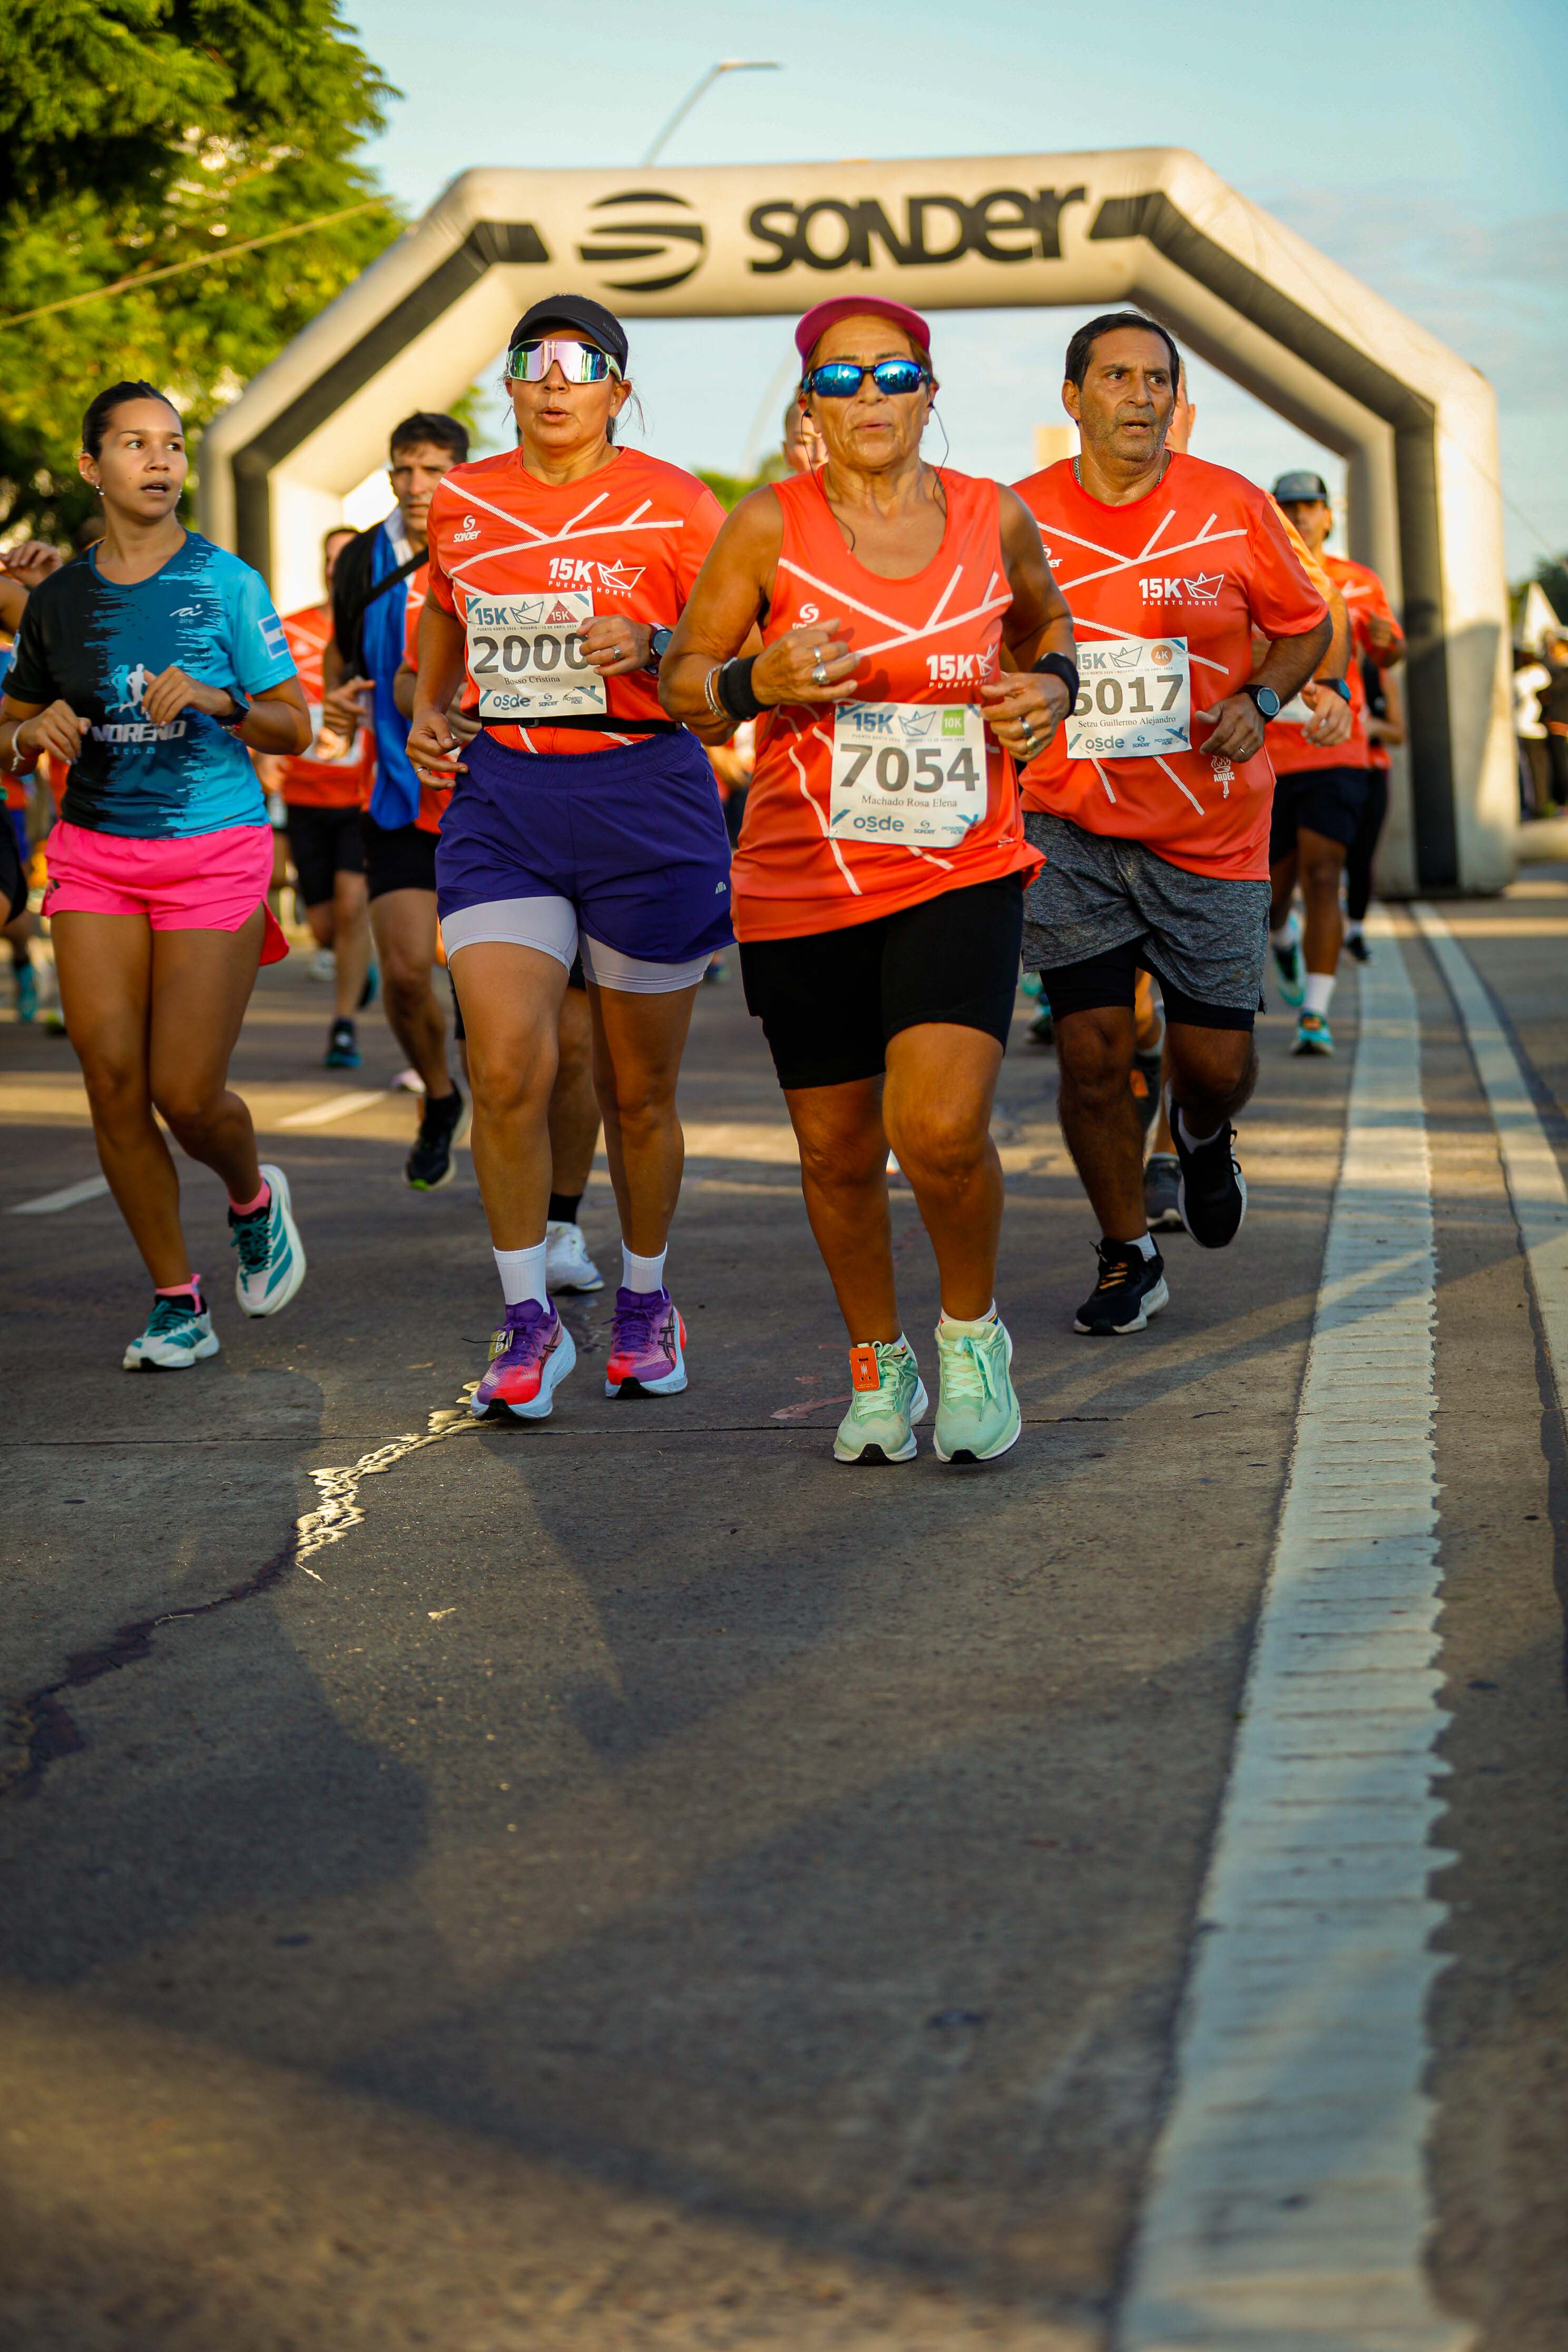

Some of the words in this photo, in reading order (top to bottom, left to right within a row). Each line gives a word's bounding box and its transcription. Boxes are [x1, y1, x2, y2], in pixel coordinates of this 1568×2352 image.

[549, 557, 595, 583] 15K
[548, 581, 592, 591] PUERTO
[596, 587, 632, 598] NORTE
[1139, 578, 1182, 599] 15K
[475, 607, 509, 625] 15K
[551, 611, 571, 621] 15K
[473, 633, 589, 673] 2000
[1155, 650, 1169, 659] 4K
[926, 654, 975, 681] 15K
[493, 693, 531, 709] osde
[1073, 674, 1184, 716] 5017
[852, 712, 894, 734] 15K
[944, 717, 961, 728] 10K
[1140, 716, 1175, 726] Alejandro
[1085, 736, 1125, 750] osde
[840, 743, 979, 792] 7054
[1214, 772, 1235, 782] ARDEC
[861, 795, 904, 806] Machado
[907, 798, 929, 807] Rosa
[933, 798, 957, 807] Elena
[853, 815, 904, 831] osde
